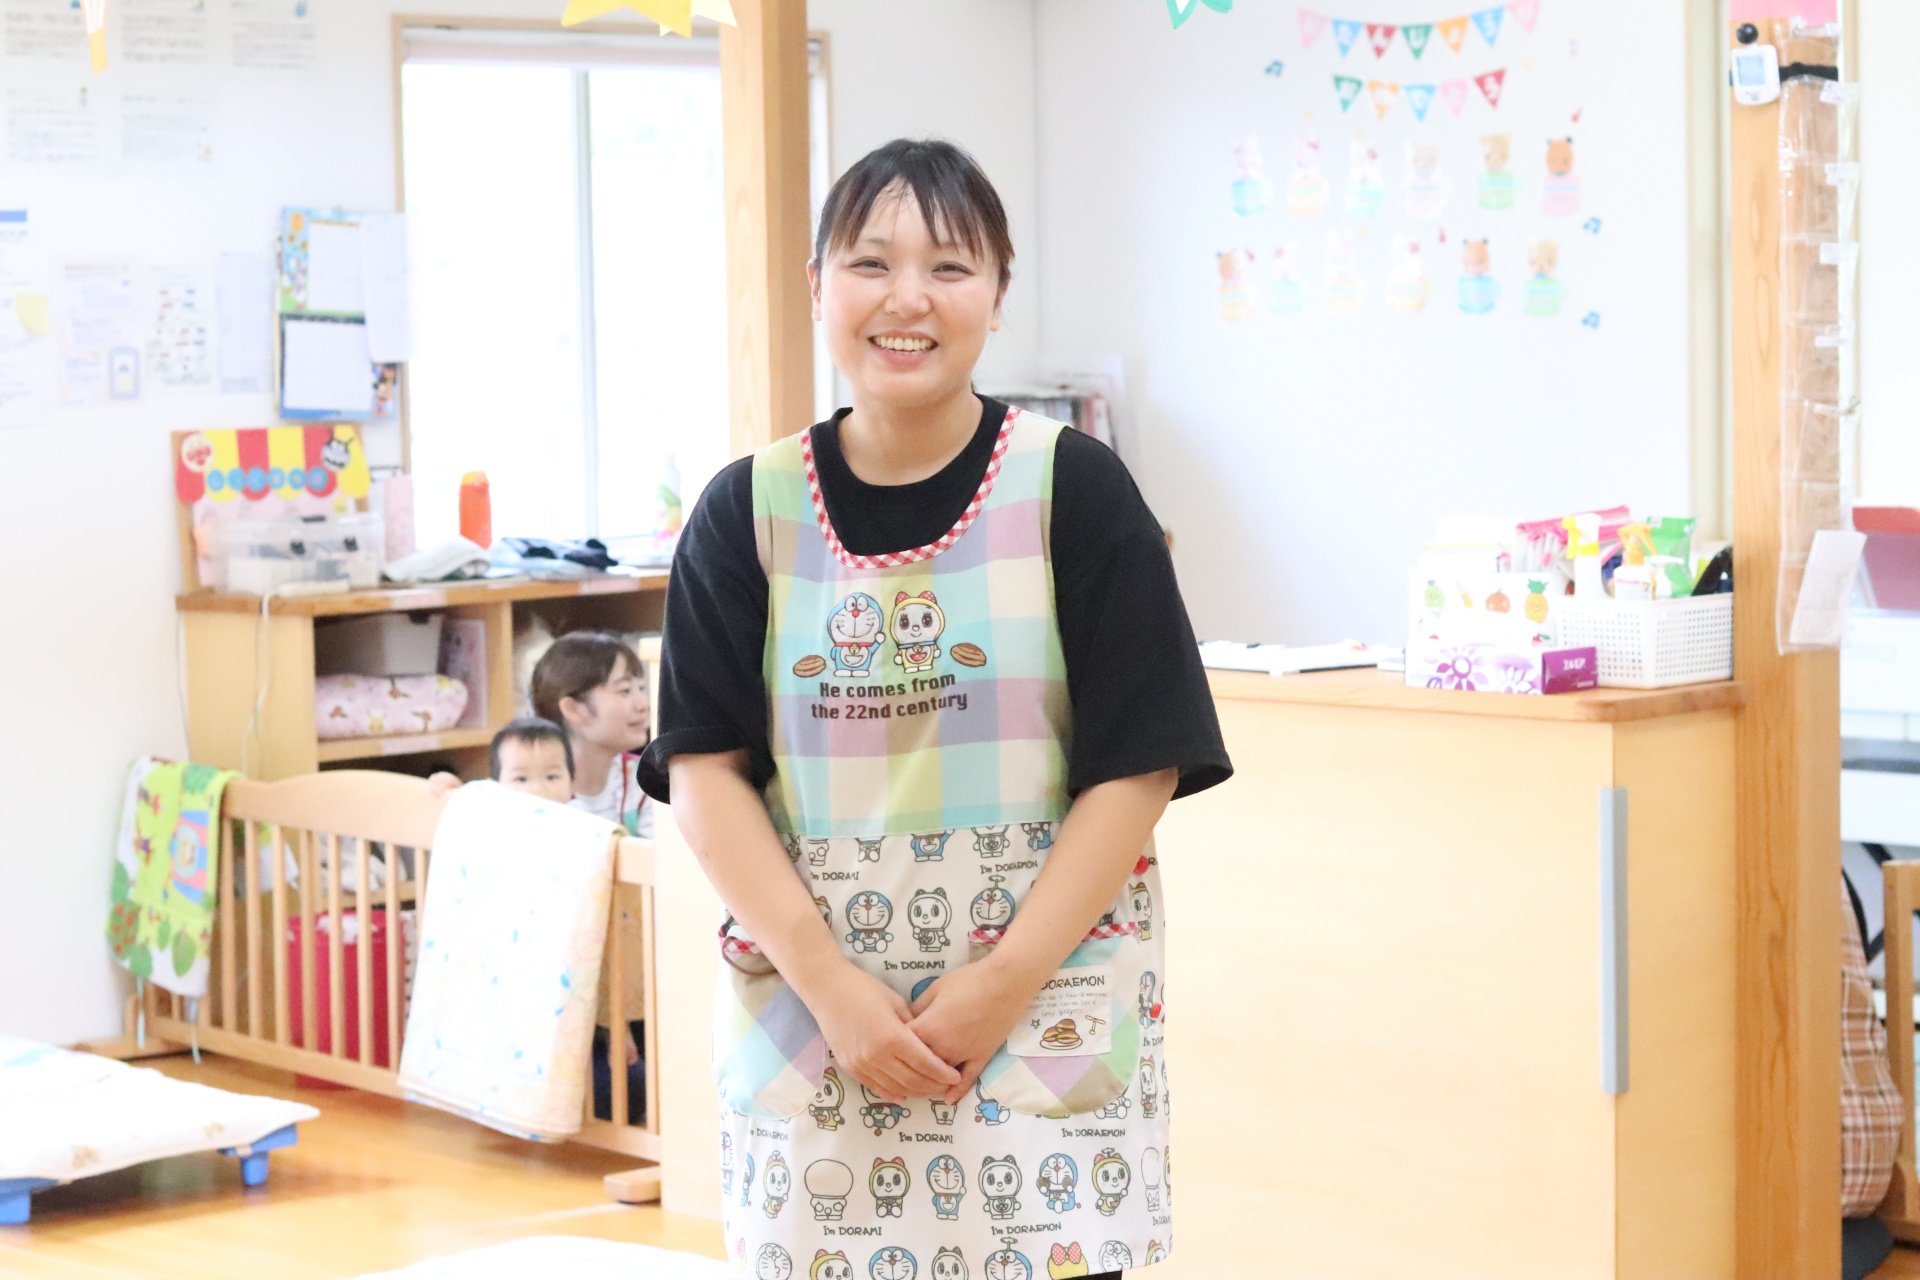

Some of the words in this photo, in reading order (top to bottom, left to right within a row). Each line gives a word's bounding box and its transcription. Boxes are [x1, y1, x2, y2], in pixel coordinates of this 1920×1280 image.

[820, 682, 841, 698] He
[846, 681, 905, 698] comes
[911, 673, 956, 693] from
[811, 704, 839, 719] the
[845, 703, 891, 719] 22nd
[896, 691, 968, 717] century
[979, 864, 993, 874] I'm
[995, 860, 1038, 873] DORAEMON
[884, 960, 898, 970] I'm
[900, 960, 946, 970] DORAMI
[899, 1132, 912, 1142] I'm
[915, 1132, 954, 1144] DORAMI
[1061, 1127, 1073, 1138] I'm
[1075, 1128, 1126, 1137] DORAEMON
[823, 1225, 836, 1236] I'm
[838, 1226, 882, 1236] DORAMI
[991, 1226, 1004, 1236] I'm
[1006, 1222, 1062, 1235] DORAEMON
